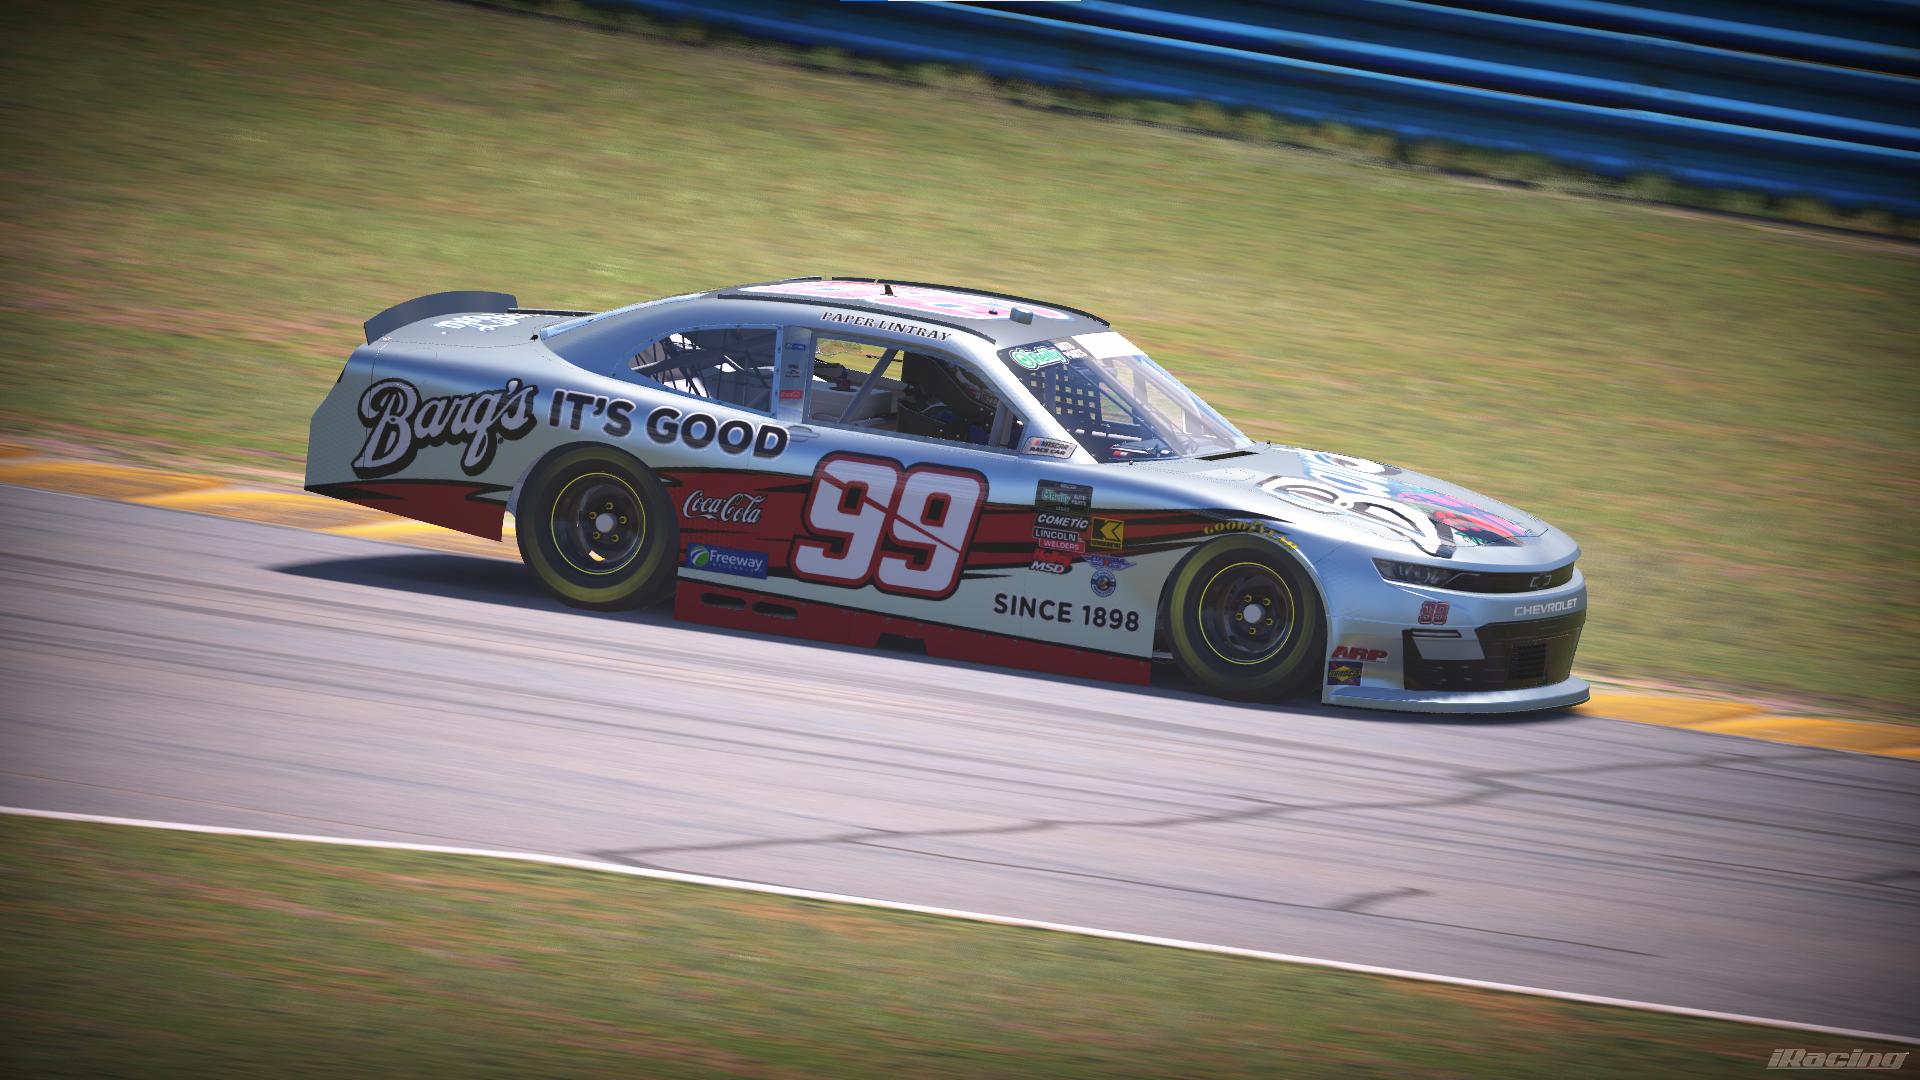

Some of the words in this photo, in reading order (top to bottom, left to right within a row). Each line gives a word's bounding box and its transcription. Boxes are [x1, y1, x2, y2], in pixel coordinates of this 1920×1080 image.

[822, 311, 875, 327] PAPER
[878, 320, 952, 341] LINTRAY
[352, 378, 539, 478] Barq's
[549, 389, 636, 438] IT'S
[645, 406, 790, 459] GOOD
[683, 490, 765, 523] Coca-Cola
[789, 453, 986, 598] 99
[1037, 514, 1089, 529] COMETIC
[1035, 529, 1076, 542] LINCOLN
[1043, 540, 1080, 551] WELDERS
[710, 550, 763, 571] Freeway
[1030, 560, 1065, 574] MSD
[994, 593, 1072, 623] SINCE
[1082, 605, 1139, 632] 1898
[1514, 598, 1577, 616] CHEVROLET
[1331, 645, 1387, 661] ARP
